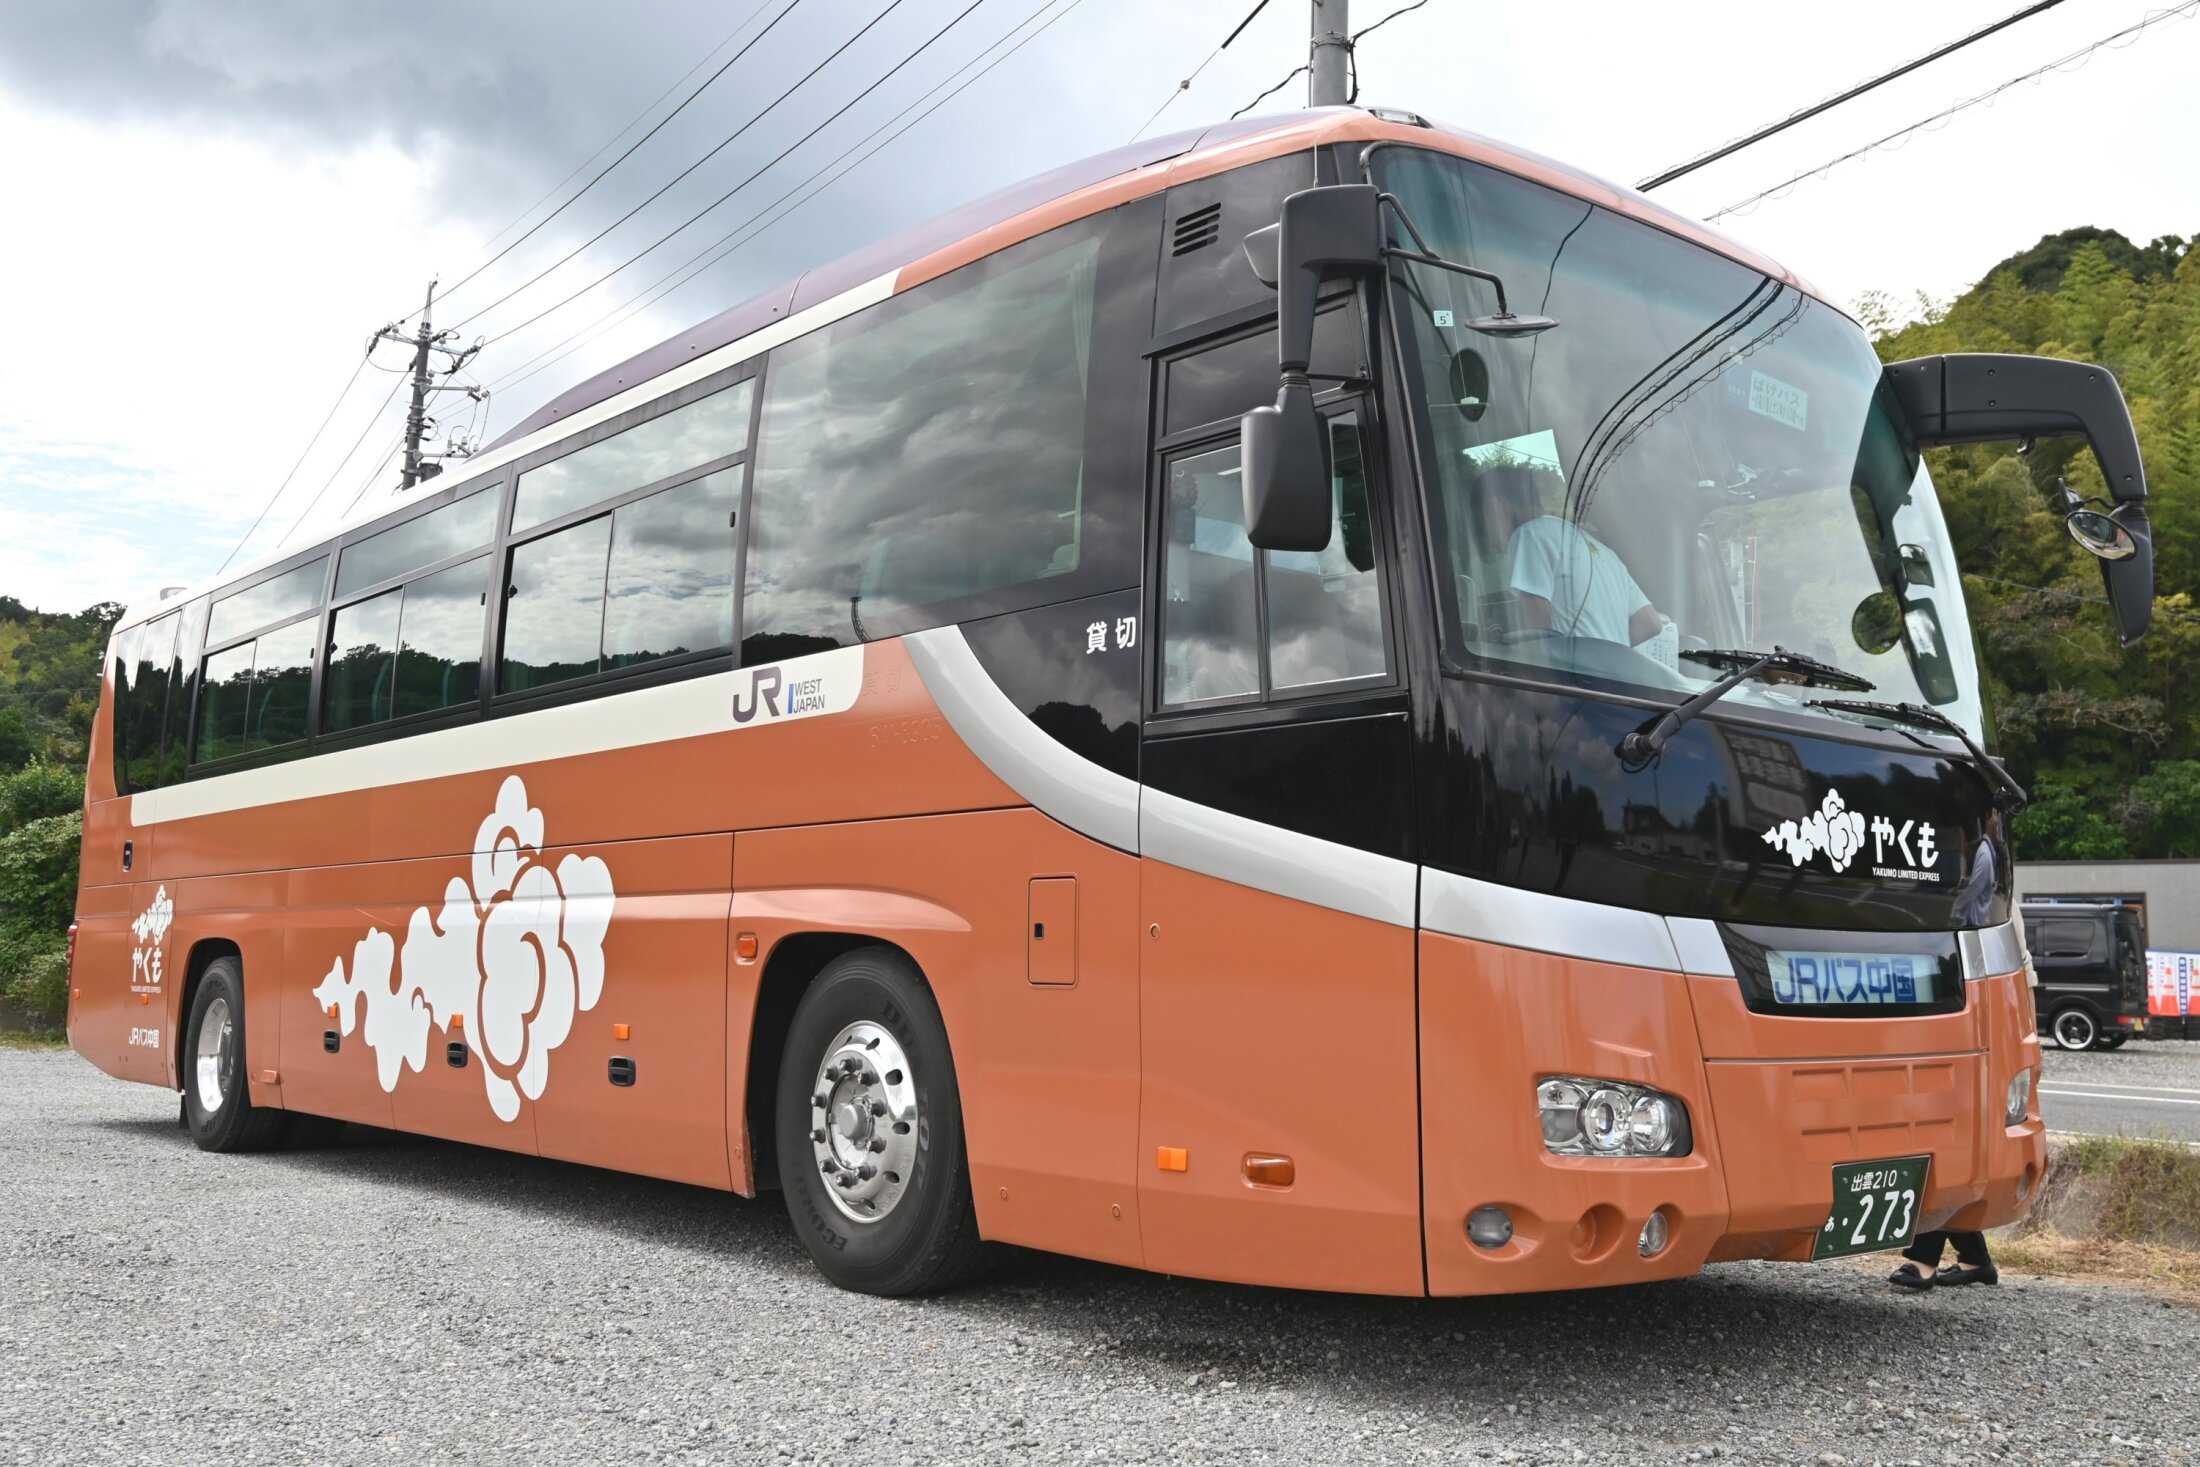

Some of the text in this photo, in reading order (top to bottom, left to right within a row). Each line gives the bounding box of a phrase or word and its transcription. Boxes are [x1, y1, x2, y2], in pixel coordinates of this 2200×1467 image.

[1086, 616, 1136, 655] 貸切
[733, 666, 782, 722] JR
[793, 693, 825, 714] JAPAN
[794, 678, 823, 697] WEST
[1871, 815, 1940, 867] やくも
[1872, 866, 1940, 882] YAKUMO LIMITED EXPRESS
[132, 947, 162, 983] やくも
[1774, 957, 1916, 1004] JRバス中国
[1850, 1170, 1898, 1192] 出雲210
